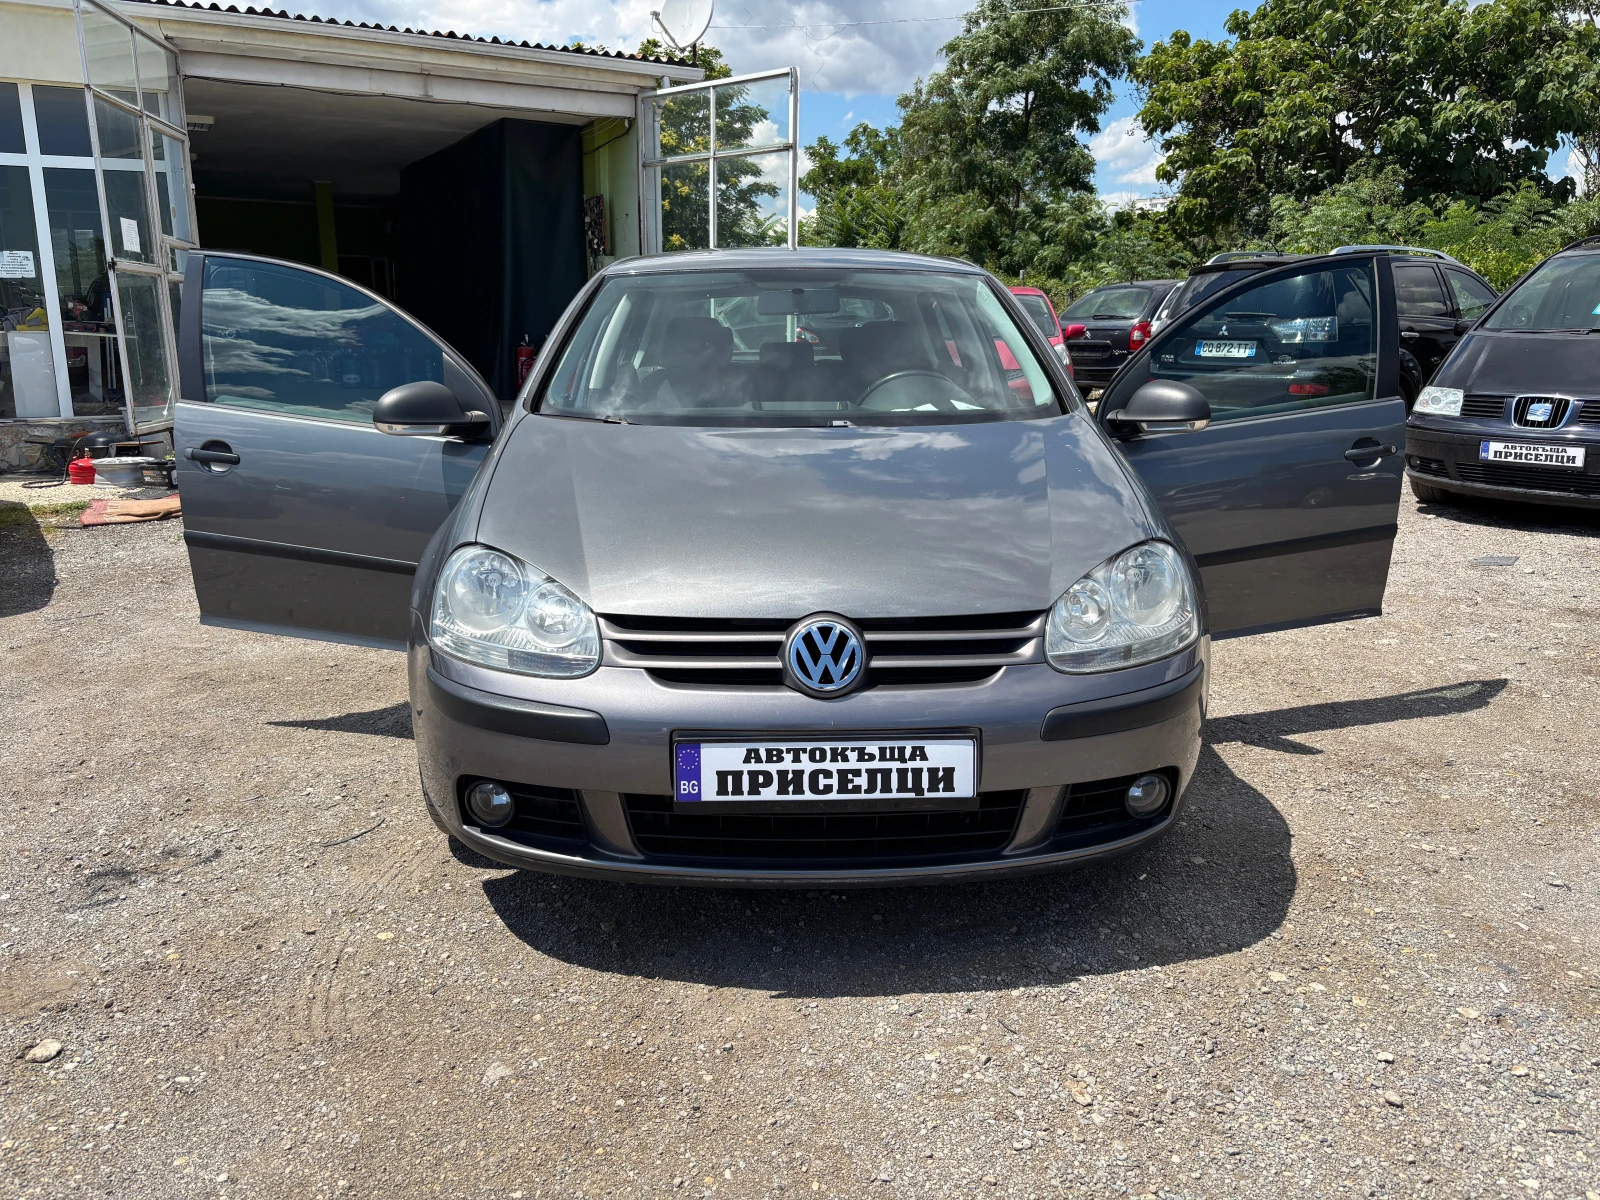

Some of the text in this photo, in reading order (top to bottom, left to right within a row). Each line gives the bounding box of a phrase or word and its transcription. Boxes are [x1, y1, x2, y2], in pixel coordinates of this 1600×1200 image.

[1502, 444, 1568, 454] АВТОКЪЩА
[1493, 450, 1577, 465] ПРИСЕЛЦИ
[742, 745, 929, 764] АВТОКЪЩА
[680, 780, 699, 794] BG
[715, 766, 956, 797] ПРИСЕЛЦИ
